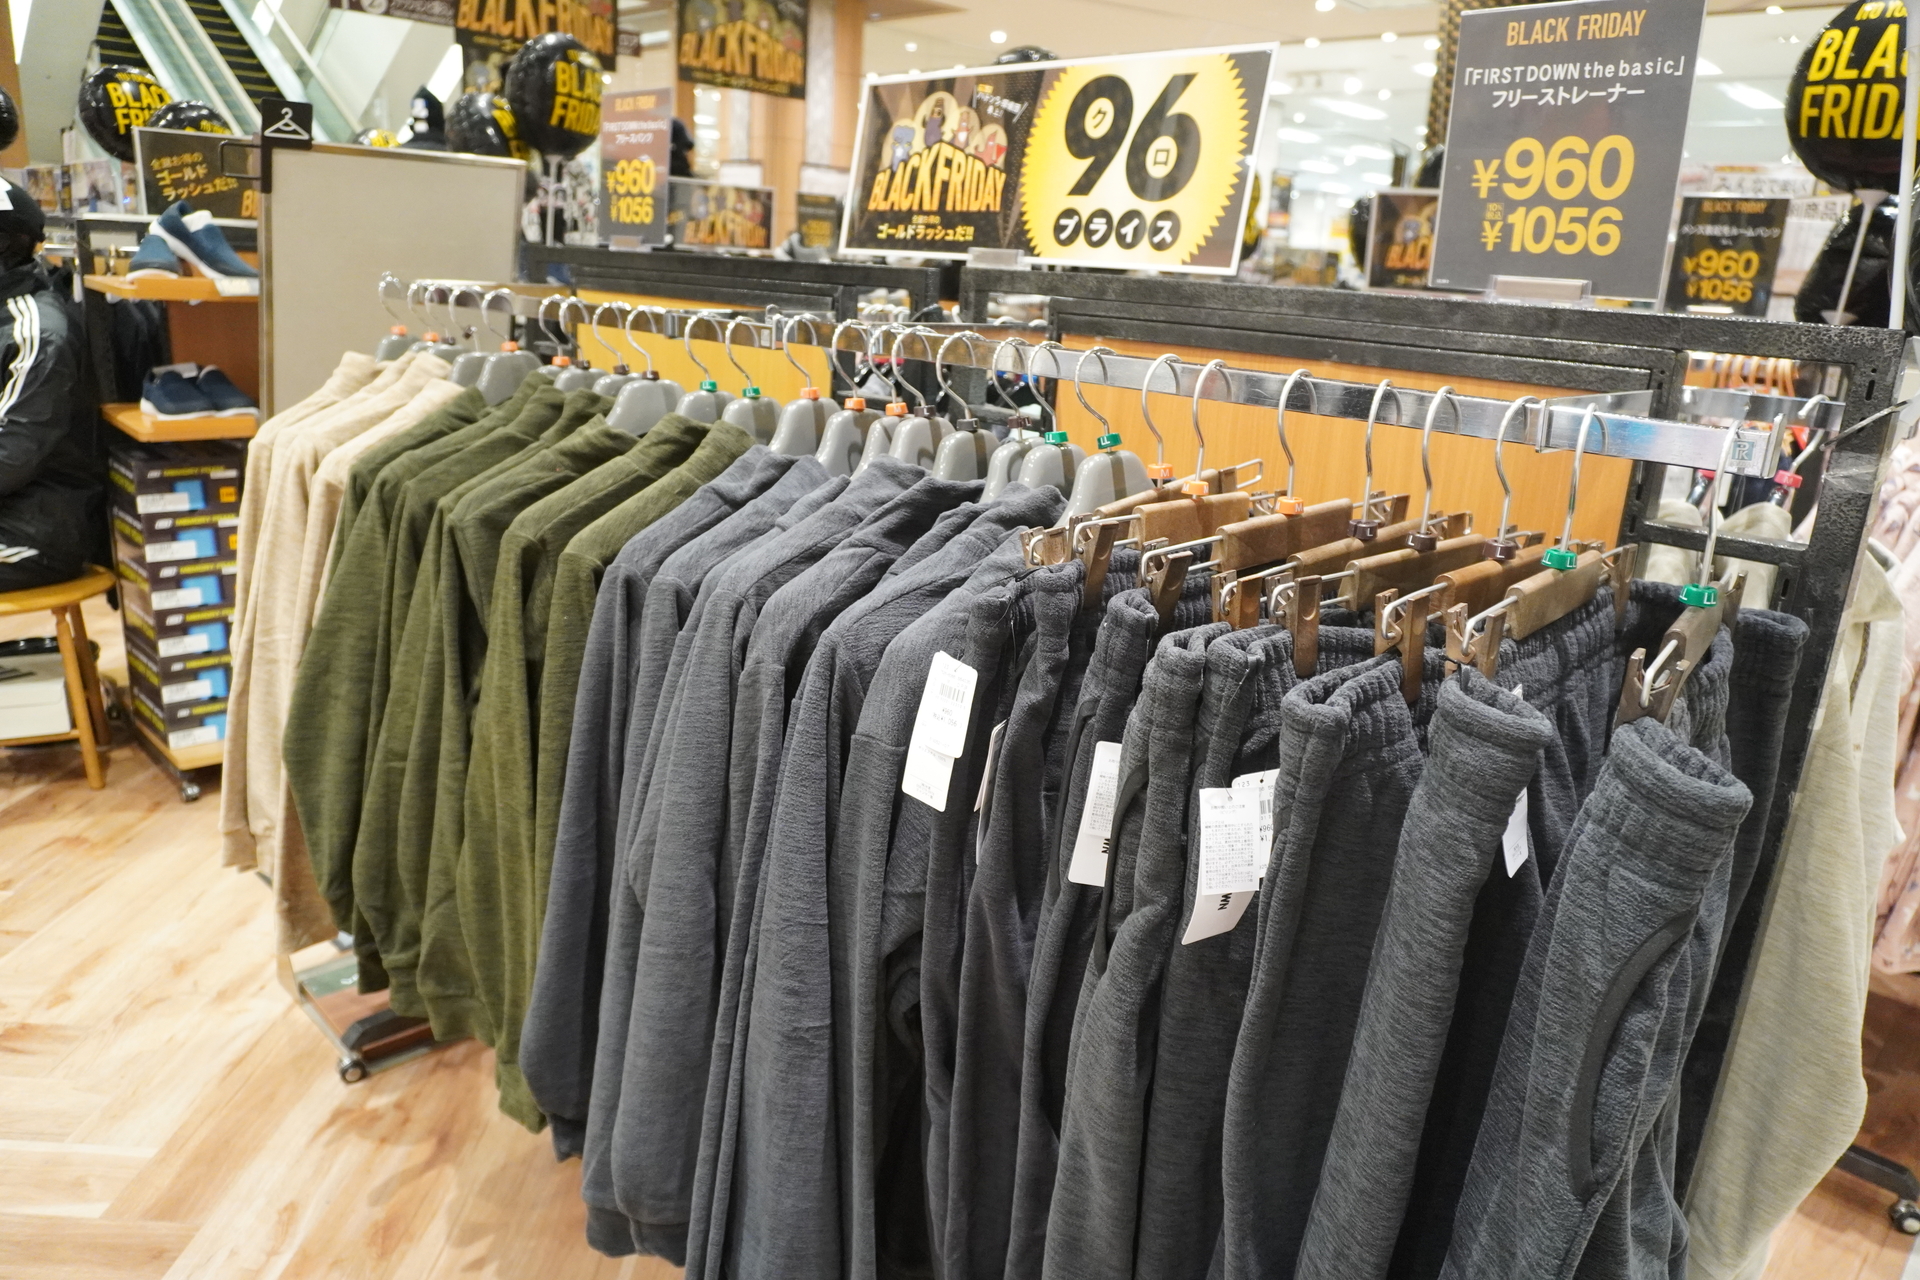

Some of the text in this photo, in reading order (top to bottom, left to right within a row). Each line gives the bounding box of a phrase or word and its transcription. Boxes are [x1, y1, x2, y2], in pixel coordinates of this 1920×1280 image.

[1506, 9, 1647, 47] BLACK FRIDAY
[1583, 61, 1615, 79] the
[1492, 83, 1646, 108] フリーストレーナー
[1092, 107, 1107, 129] ク
[1065, 72, 1201, 203] 96
[155, 163, 208, 186] ゴールド
[606, 159, 656, 196] ¥960
[1471, 134, 1635, 201] ¥960
[1058, 215, 1174, 245] プライス
[1480, 206, 1624, 257] ¥1056
[1682, 248, 1760, 279] ¥960
[1045, 433, 1055, 443] LL
[1100, 436, 1111, 446] LL
[1160, 469, 1169, 477] M
[1295, 503, 1303, 512] M
[1408, 535, 1414, 546] L
[1496, 547, 1505, 558] L
[1566, 556, 1576, 567] LL
[1703, 592, 1717, 604] LL
